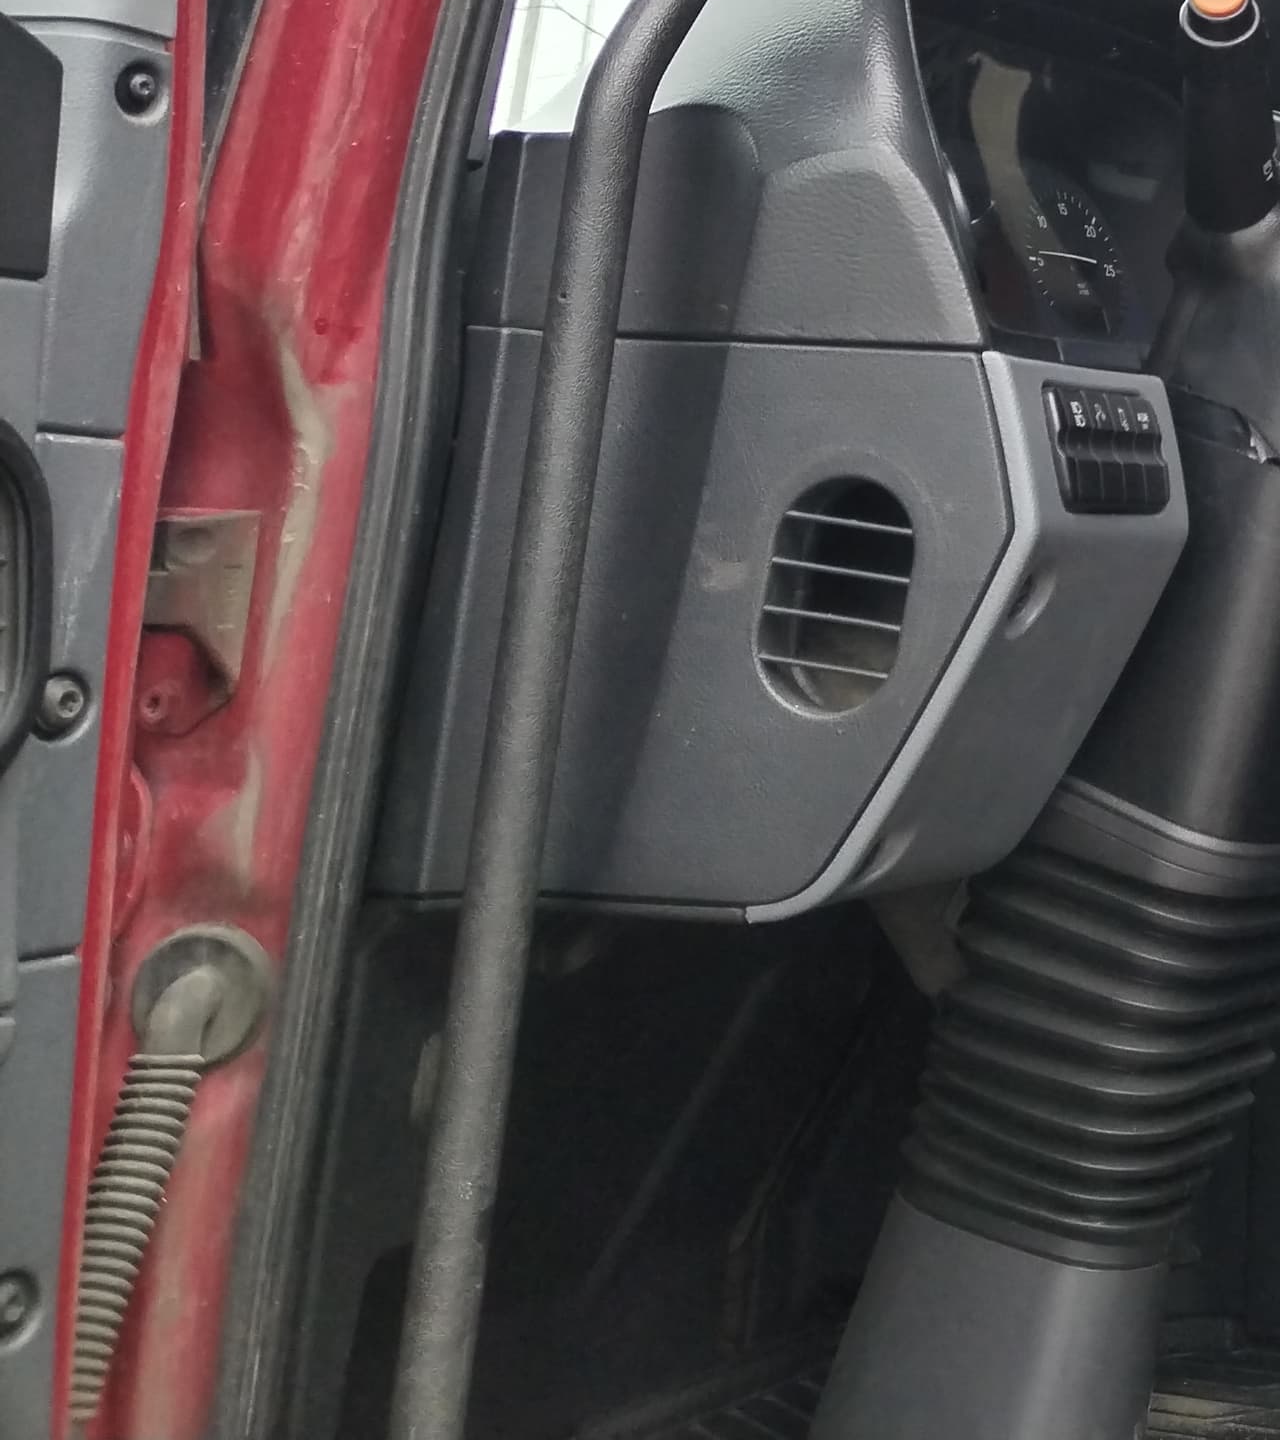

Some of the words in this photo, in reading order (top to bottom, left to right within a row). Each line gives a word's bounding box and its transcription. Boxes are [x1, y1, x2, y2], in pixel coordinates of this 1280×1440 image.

[1036, 215, 1048, 229] 10
[1083, 224, 1097, 238] 20
[1103, 263, 1116, 278] 25
